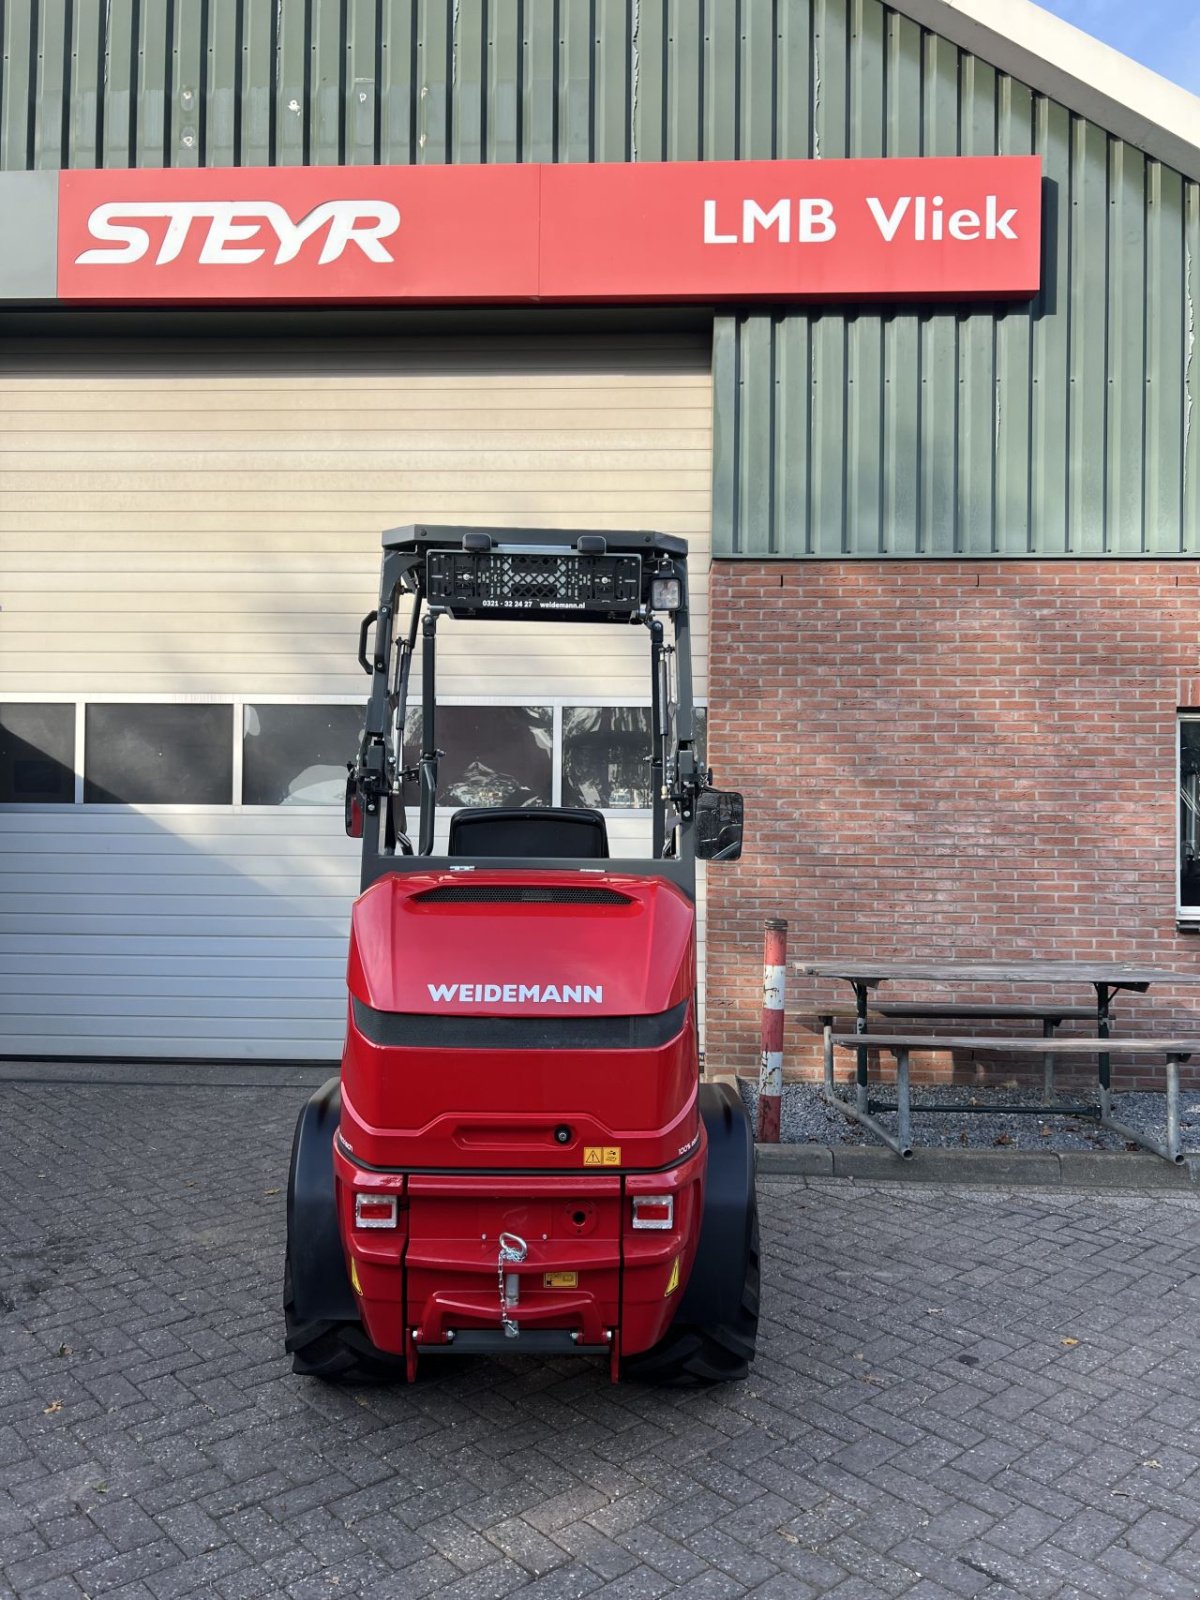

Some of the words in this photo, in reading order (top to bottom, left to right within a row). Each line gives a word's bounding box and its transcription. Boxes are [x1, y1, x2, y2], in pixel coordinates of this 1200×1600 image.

[75, 200, 401, 266] STEYR
[703, 198, 838, 244] LMB
[866, 195, 1019, 242] Vliek
[514, 600, 523, 608] 24
[540, 601, 586, 609] weidemann.nl
[427, 984, 603, 1003] WEIDEMANN
